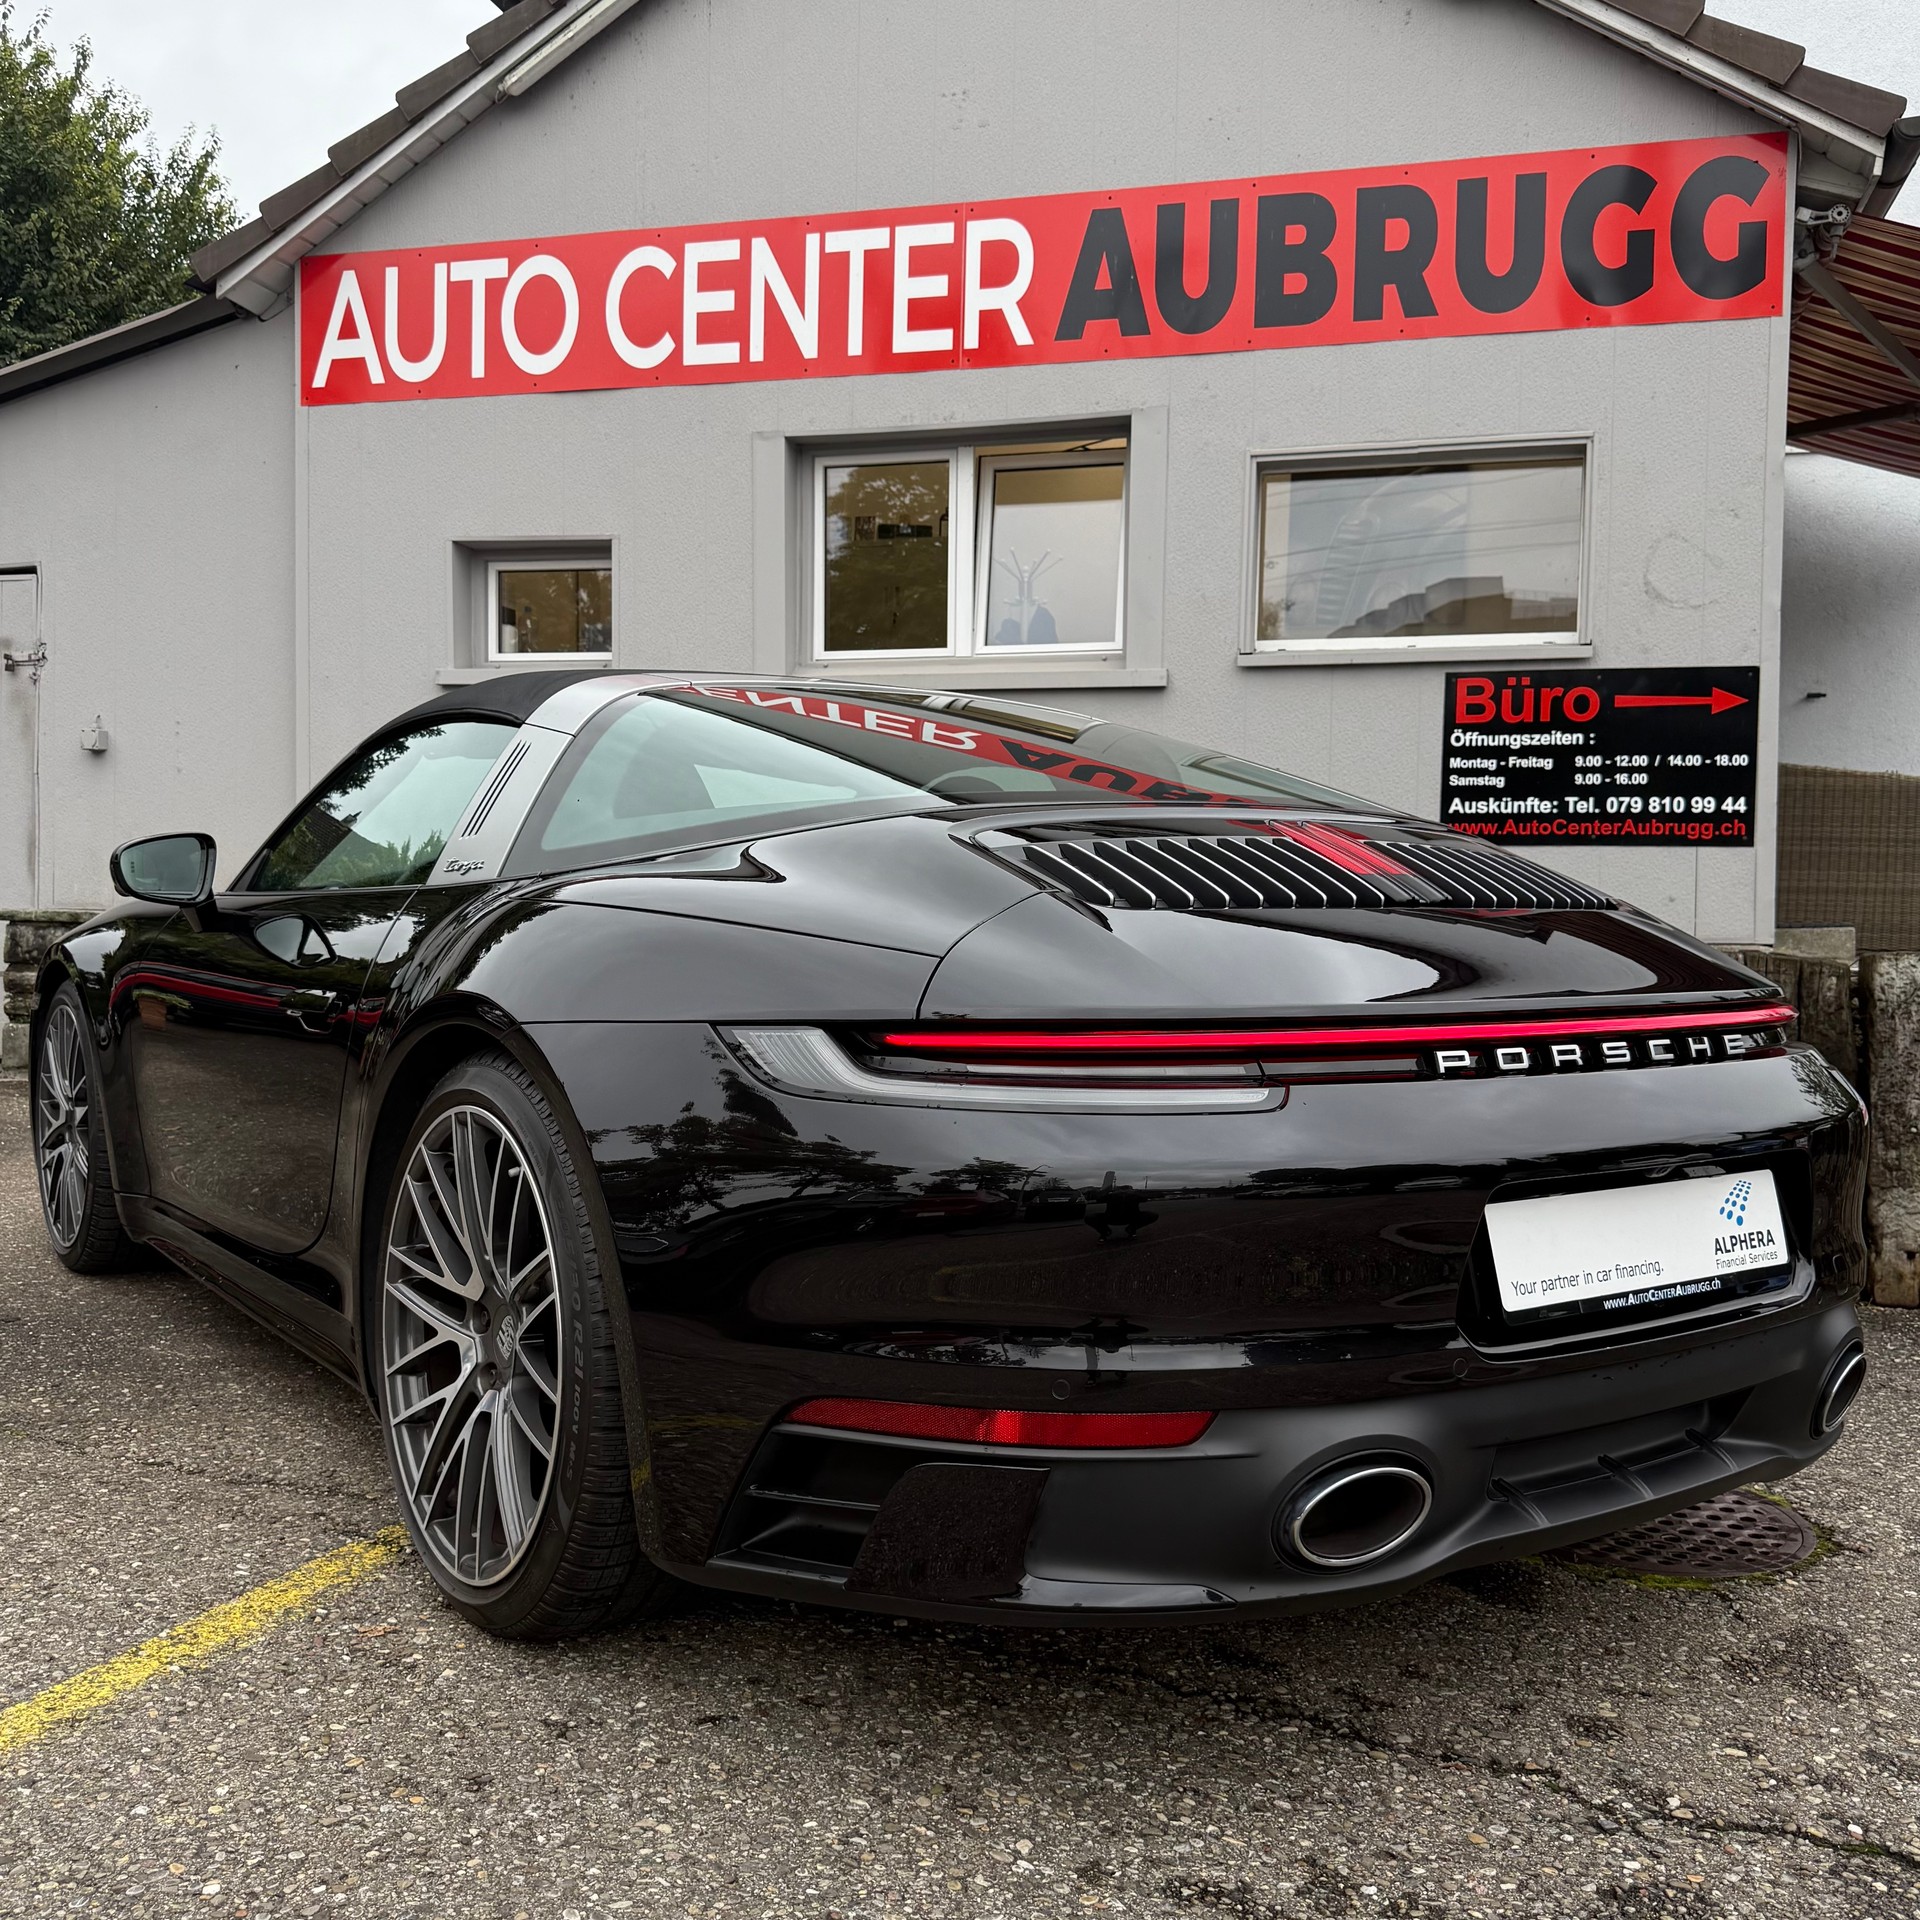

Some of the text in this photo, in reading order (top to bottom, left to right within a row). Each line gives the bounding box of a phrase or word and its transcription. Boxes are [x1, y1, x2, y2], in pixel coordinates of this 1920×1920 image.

[312, 155, 1771, 389] AUTO CENTER AUBRUGG
[1455, 677, 1600, 724] Büro
[1450, 729, 1584, 749] Öffnungszeiten
[1449, 757, 1497, 770] Montag
[1508, 757, 1553, 770] Freitag
[1575, 756, 1602, 768] 9.00
[1614, 755, 1648, 767] 12.00
[1667, 755, 1701, 767] 14.00
[1714, 754, 1749, 767] 18.00
[1449, 774, 1505, 788] Samstag
[1574, 774, 1601, 785] 9.00
[1614, 773, 1648, 785] 16.00
[1448, 797, 1747, 814] Auskünfte: Tel. 079 810 99 44
[1434, 1034, 1746, 1074] PORSCHE
[1714, 1229, 1776, 1256] ALPHERA
[1716, 1250, 1778, 1270] Financial Services
[1511, 1259, 1664, 1297] Your partner in car financing.
